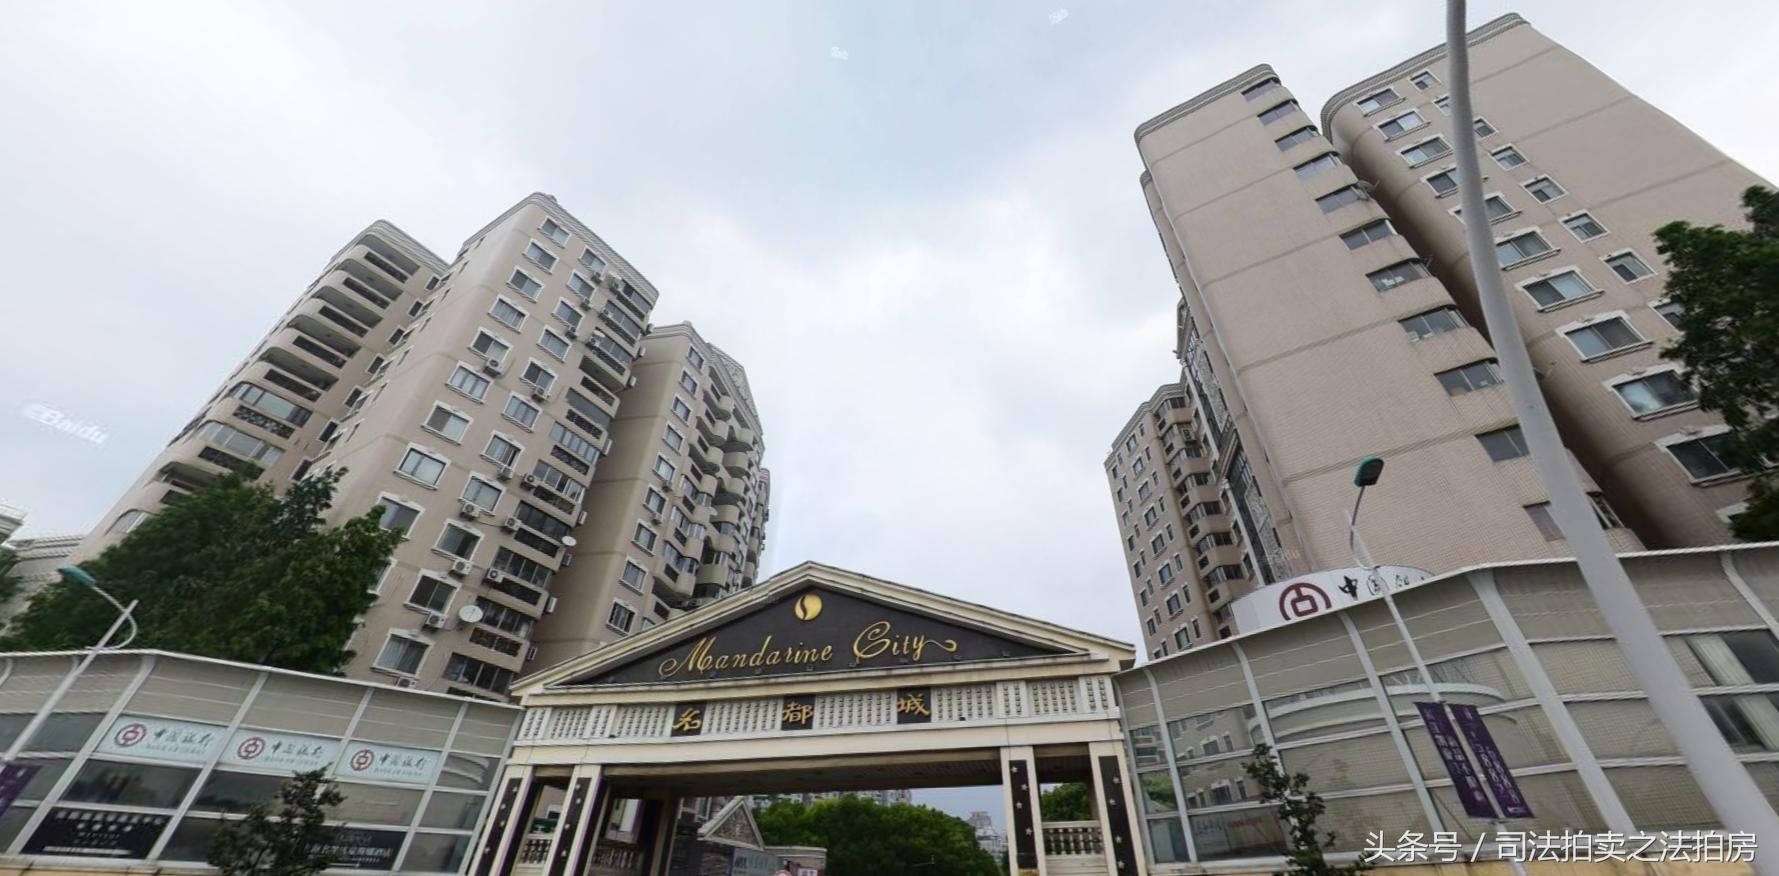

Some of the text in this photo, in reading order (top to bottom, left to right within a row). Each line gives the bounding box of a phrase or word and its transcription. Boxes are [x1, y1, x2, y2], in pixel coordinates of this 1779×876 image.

[658, 621, 957, 678] Mandarine City
[672, 693, 931, 732] 名都城
